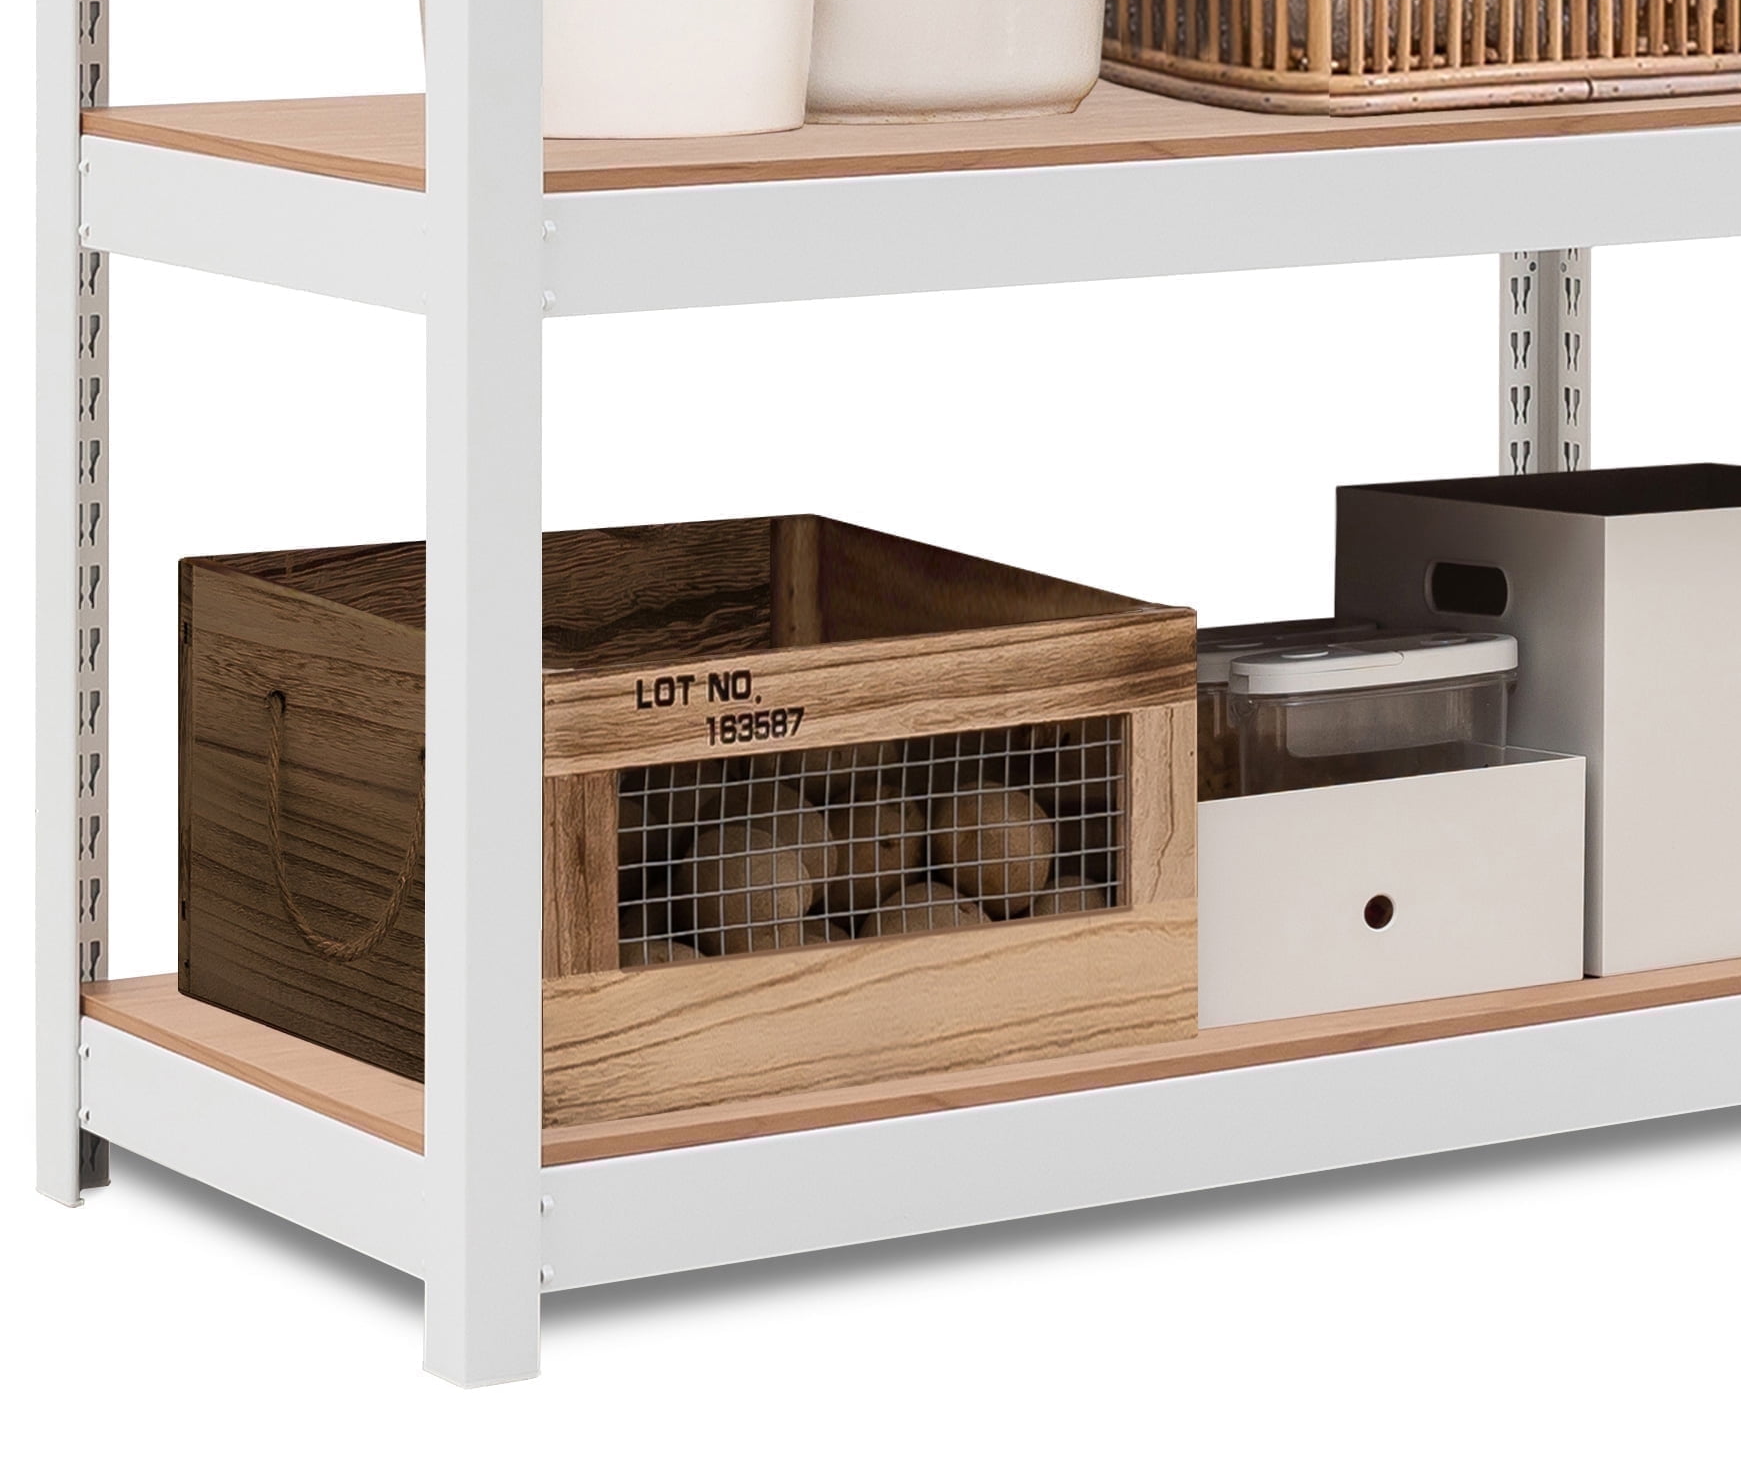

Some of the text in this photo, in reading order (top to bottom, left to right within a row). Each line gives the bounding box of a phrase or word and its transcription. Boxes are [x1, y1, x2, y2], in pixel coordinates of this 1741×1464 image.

[636, 669, 763, 710] LOT NO.
[706, 706, 805, 747] 163587
